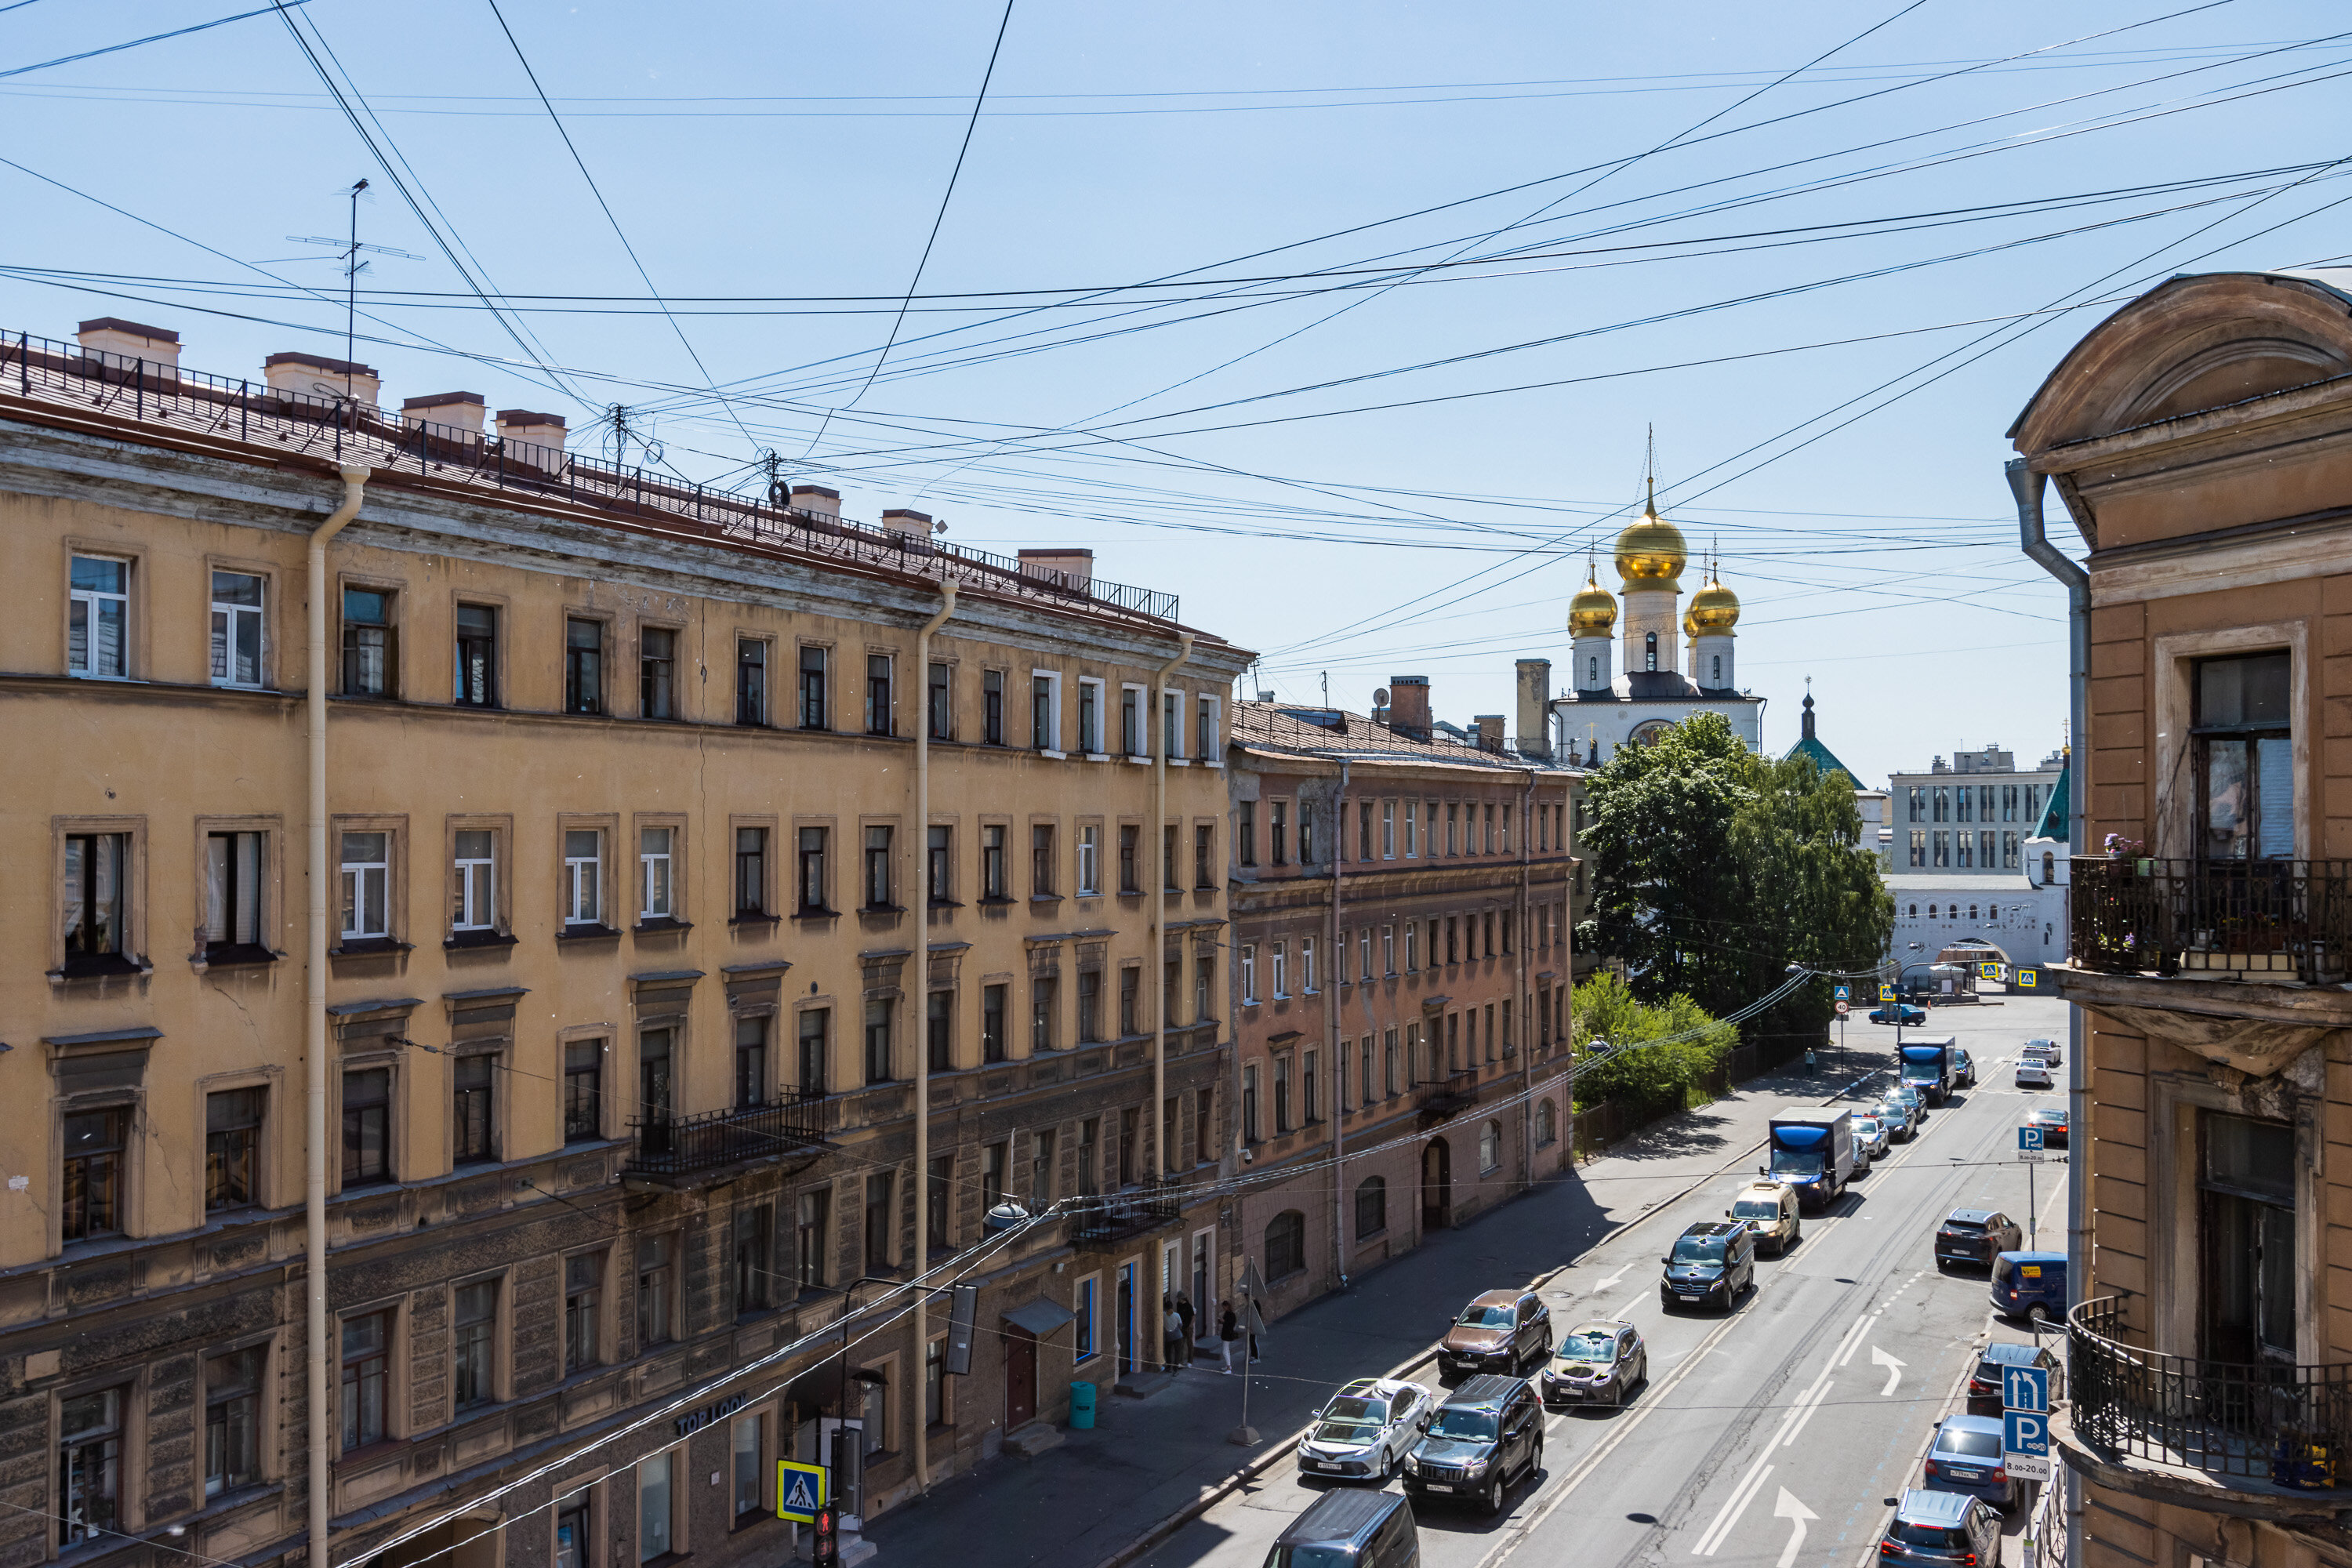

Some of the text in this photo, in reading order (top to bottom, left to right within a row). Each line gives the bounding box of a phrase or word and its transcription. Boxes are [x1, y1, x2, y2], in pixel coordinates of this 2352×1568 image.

[2025, 1130, 2038, 1148] P
[677, 1411, 706, 1436] TOP
[2016, 1417, 2040, 1450] P
[2007, 1462, 2047, 1475] 8.00-20.00
